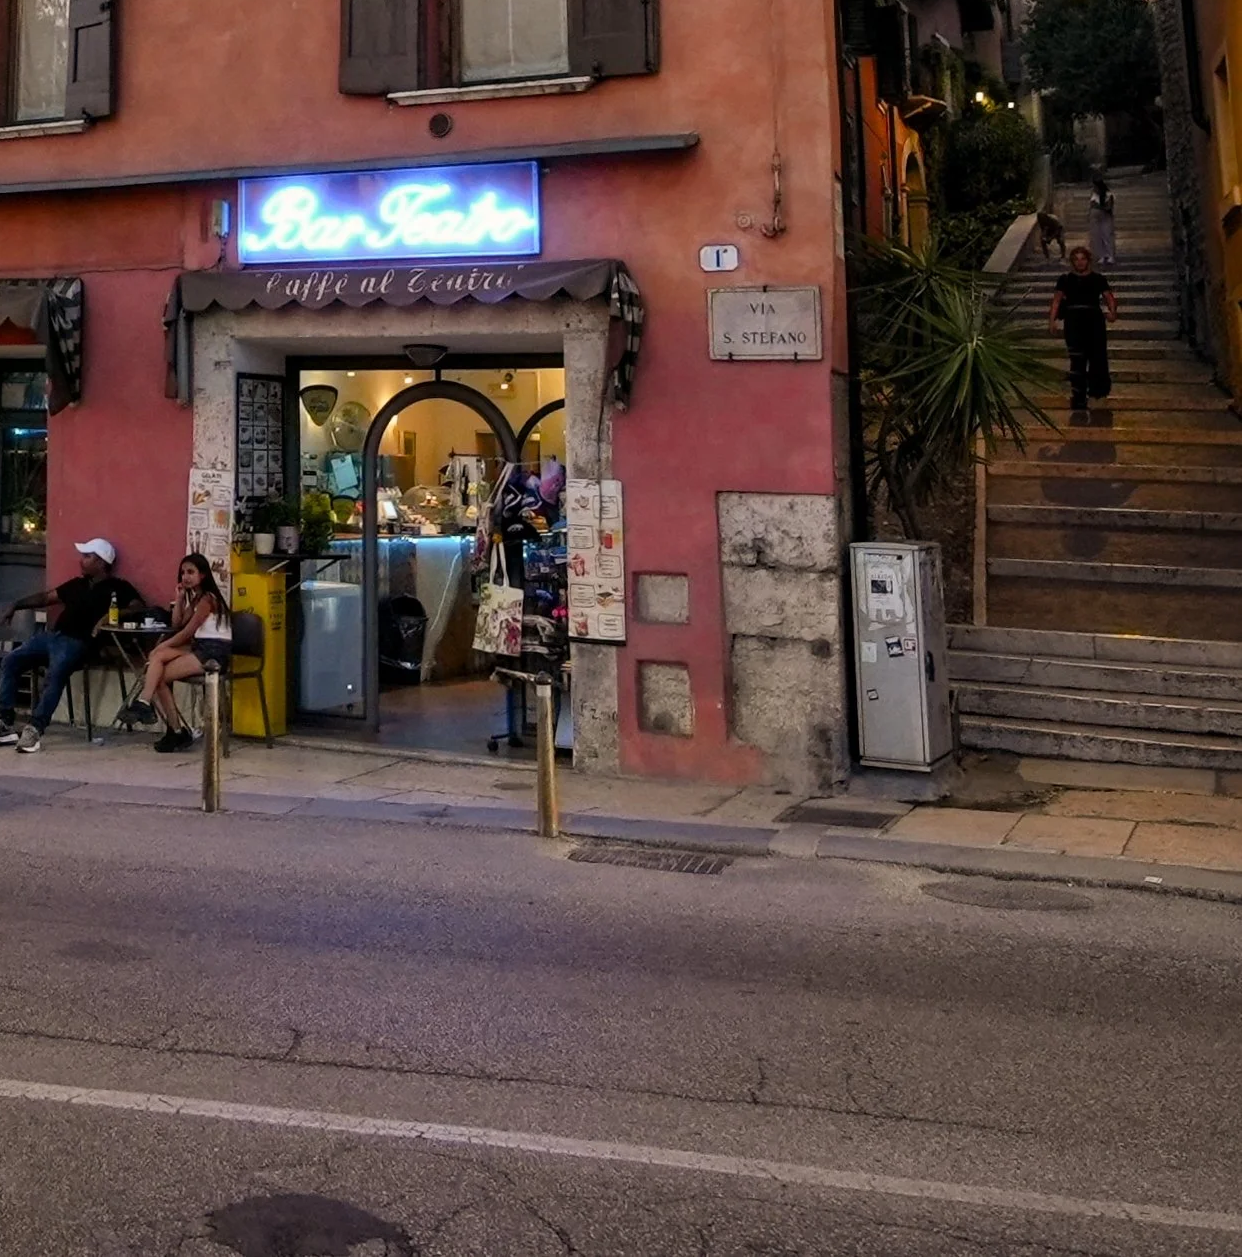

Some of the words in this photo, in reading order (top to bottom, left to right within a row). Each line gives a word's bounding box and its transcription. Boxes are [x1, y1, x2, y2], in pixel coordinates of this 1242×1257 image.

[244, 185, 365, 251] Bar
[364, 183, 537, 248] Teatro
[360, 269, 395, 293] al
[749, 302, 776, 315] VIA
[723, 333, 735, 344] S.
[742, 331, 806, 344] STEFANO
